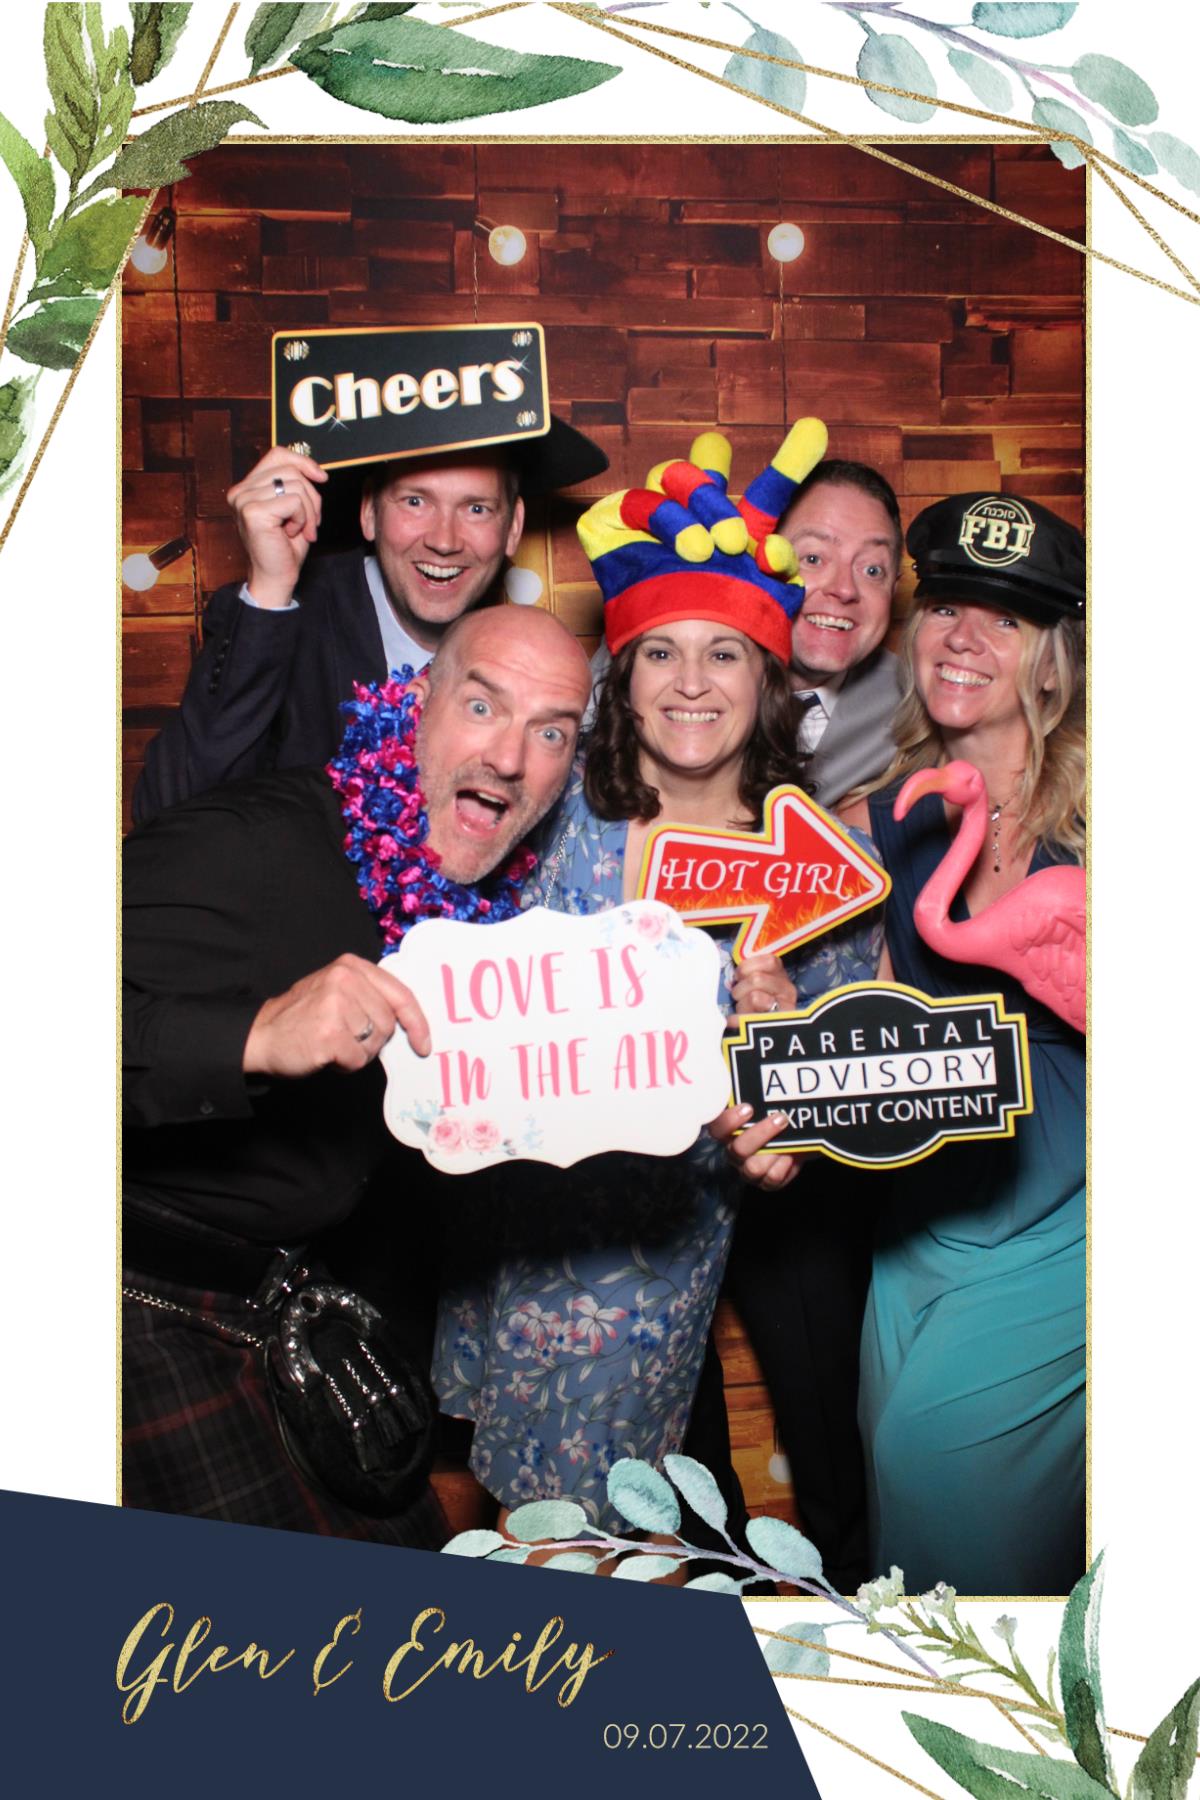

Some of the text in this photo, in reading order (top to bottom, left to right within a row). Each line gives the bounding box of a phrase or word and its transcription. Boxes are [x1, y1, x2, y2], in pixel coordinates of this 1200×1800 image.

[289, 359, 525, 427] Cheers
[958, 514, 1035, 556] FBI
[661, 858, 852, 900] HOT GIRL
[441, 944, 646, 1024] LOVE IS
[759, 1019, 992, 1058] PARENTAL
[510, 1038, 591, 1100] THE
[614, 1030, 692, 1090] AIR
[765, 1051, 992, 1097] ADVISORY
[767, 1093, 997, 1128] XPLICIT CONTENT
